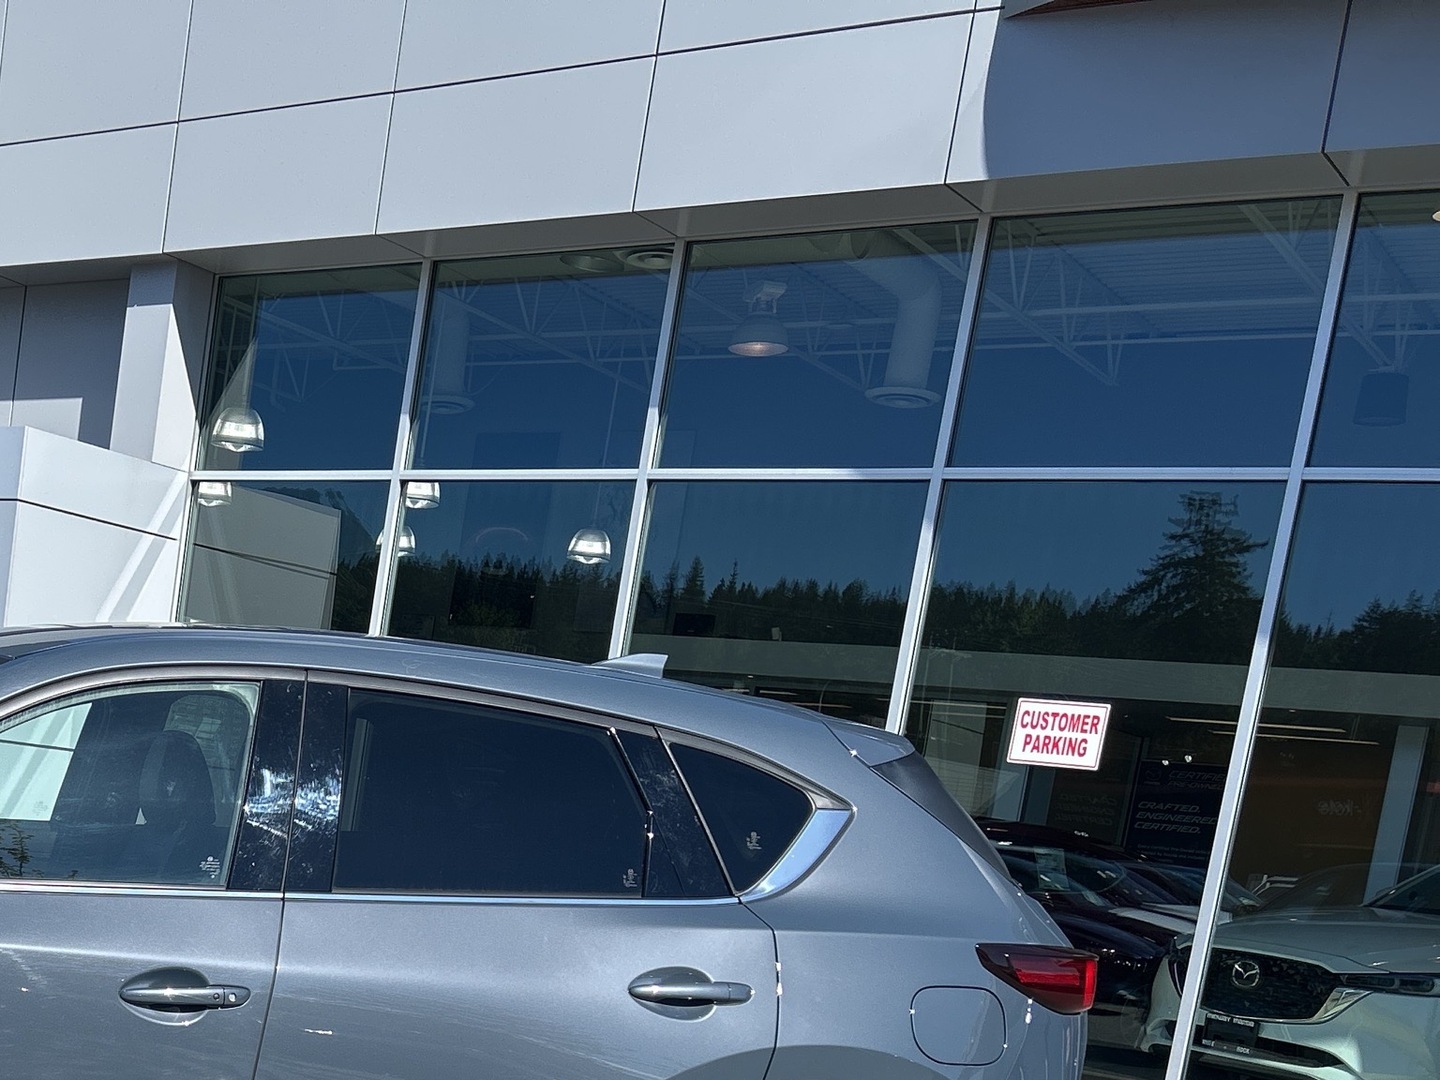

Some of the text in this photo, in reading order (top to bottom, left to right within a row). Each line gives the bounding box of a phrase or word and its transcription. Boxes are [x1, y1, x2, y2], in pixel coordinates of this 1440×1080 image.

[1020, 710, 1101, 735] CUSTOMER
[1022, 733, 1089, 758] PARKING
[1138, 801, 1200, 813] CRAFTED.
[1134, 821, 1201, 834] CERTIFIED.
